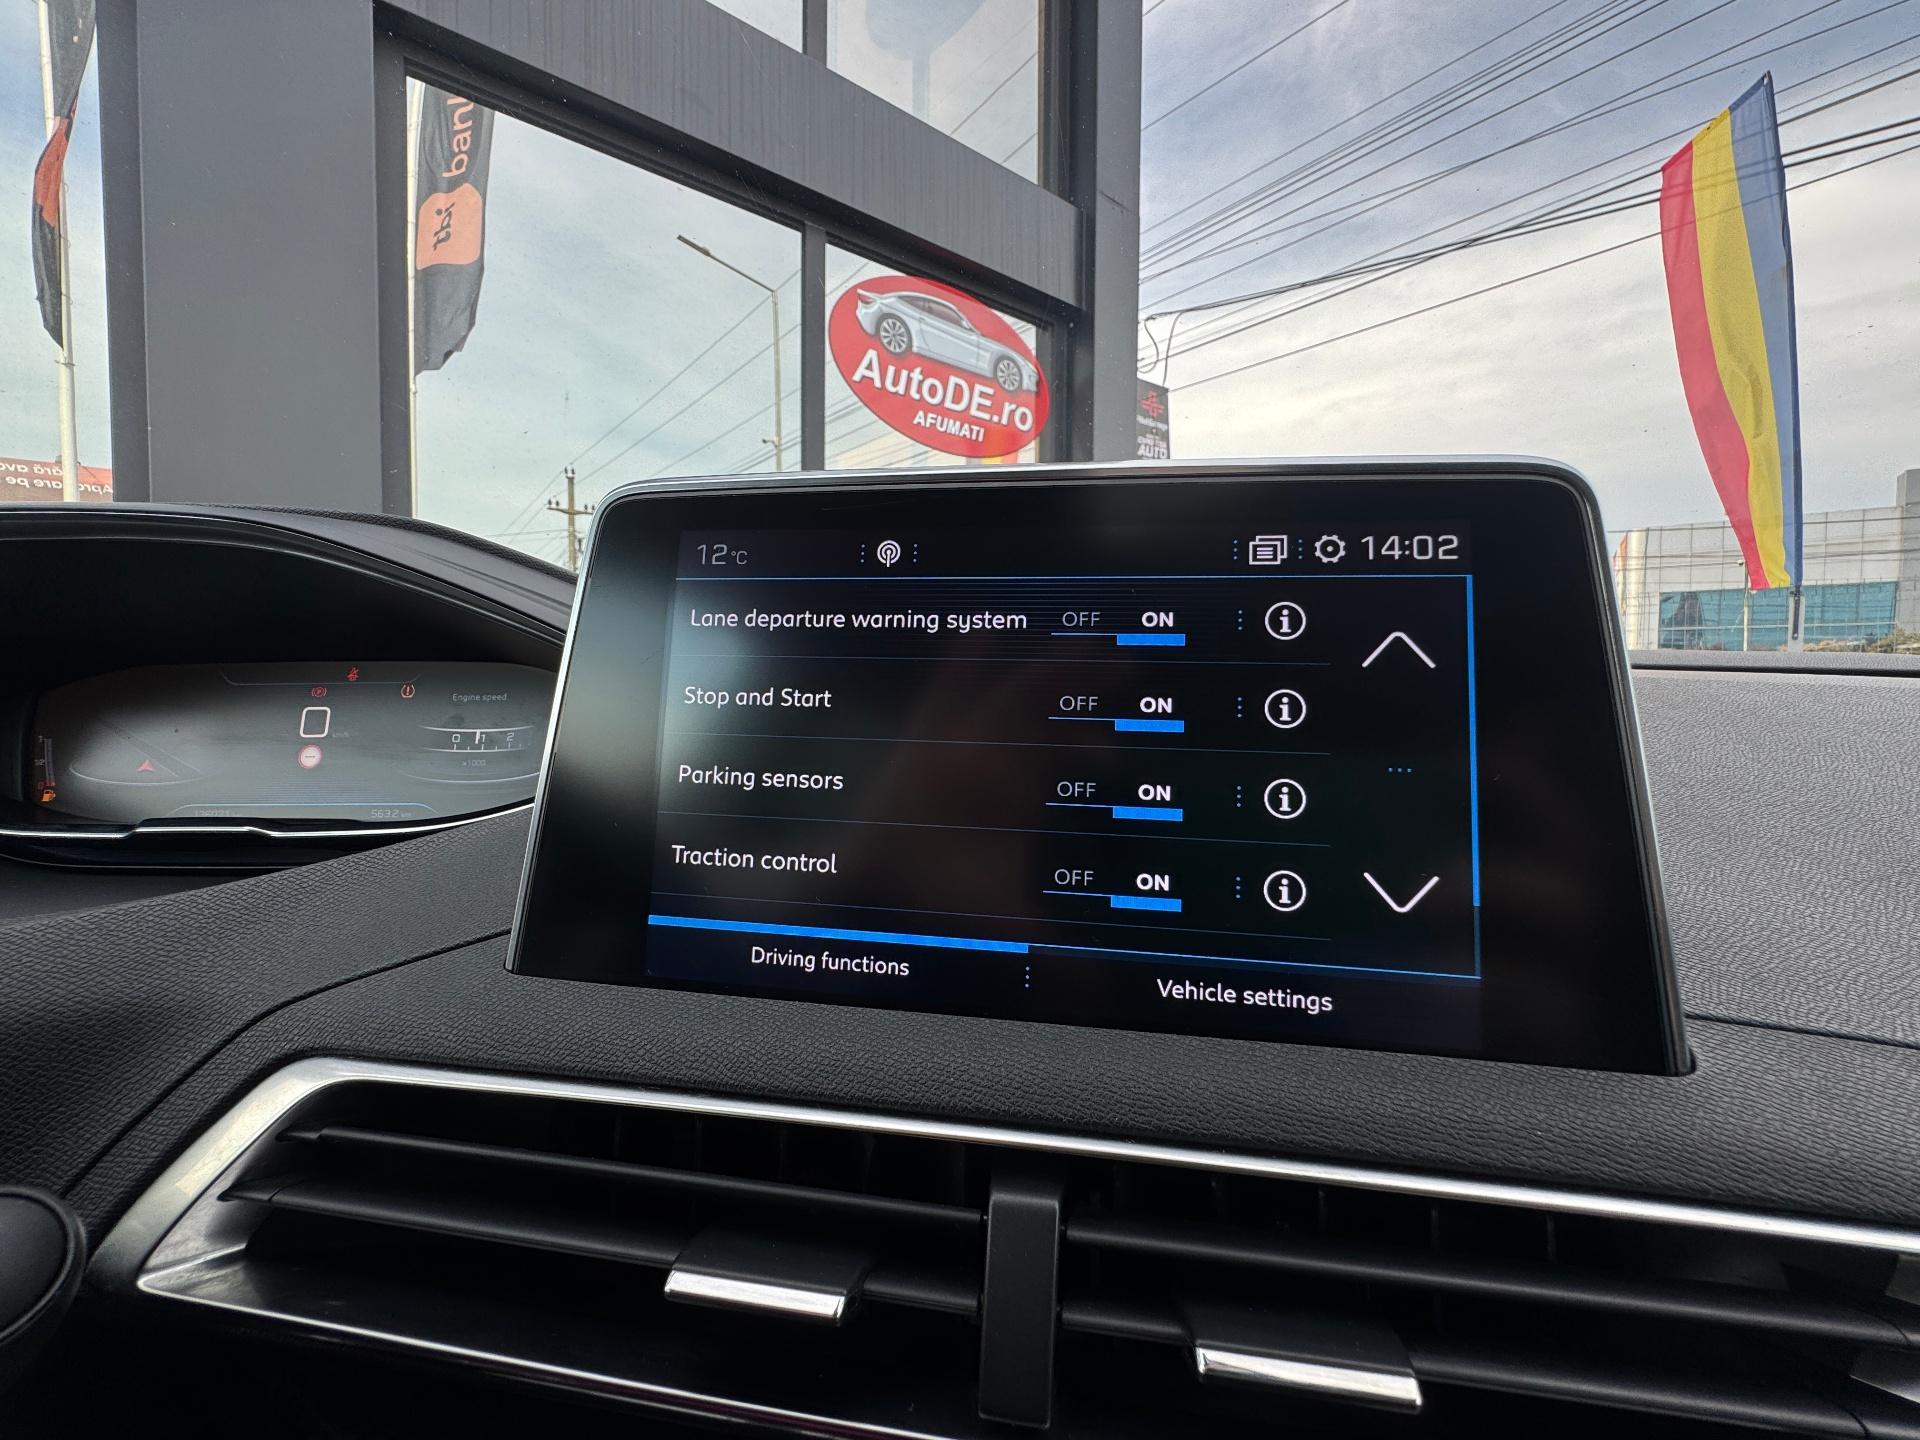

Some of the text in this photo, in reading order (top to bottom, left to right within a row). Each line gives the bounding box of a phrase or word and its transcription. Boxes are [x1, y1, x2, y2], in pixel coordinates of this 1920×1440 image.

[432, 202, 456, 251] tbi
[852, 348, 1034, 432] AutoDE.ro
[913, 410, 985, 443] AFUMATI
[1361, 534, 1460, 561] 14:02
[691, 609, 1028, 634] Lane departure warning system
[1062, 611, 1174, 628] OFF ON
[453, 693, 508, 703] Engine speed
[683, 686, 832, 709] Stop and Start
[1059, 695, 1173, 714] OFF ON
[451, 733, 461, 743] 0
[506, 732, 515, 742] 2
[678, 765, 844, 791] Parking sensors
[1057, 781, 1171, 802] OFF ON
[671, 844, 838, 874] Traction control
[1054, 868, 1170, 892] OFF ON
[751, 945, 910, 977] Driving functions
[1157, 978, 1333, 1015] Vehicle settings
